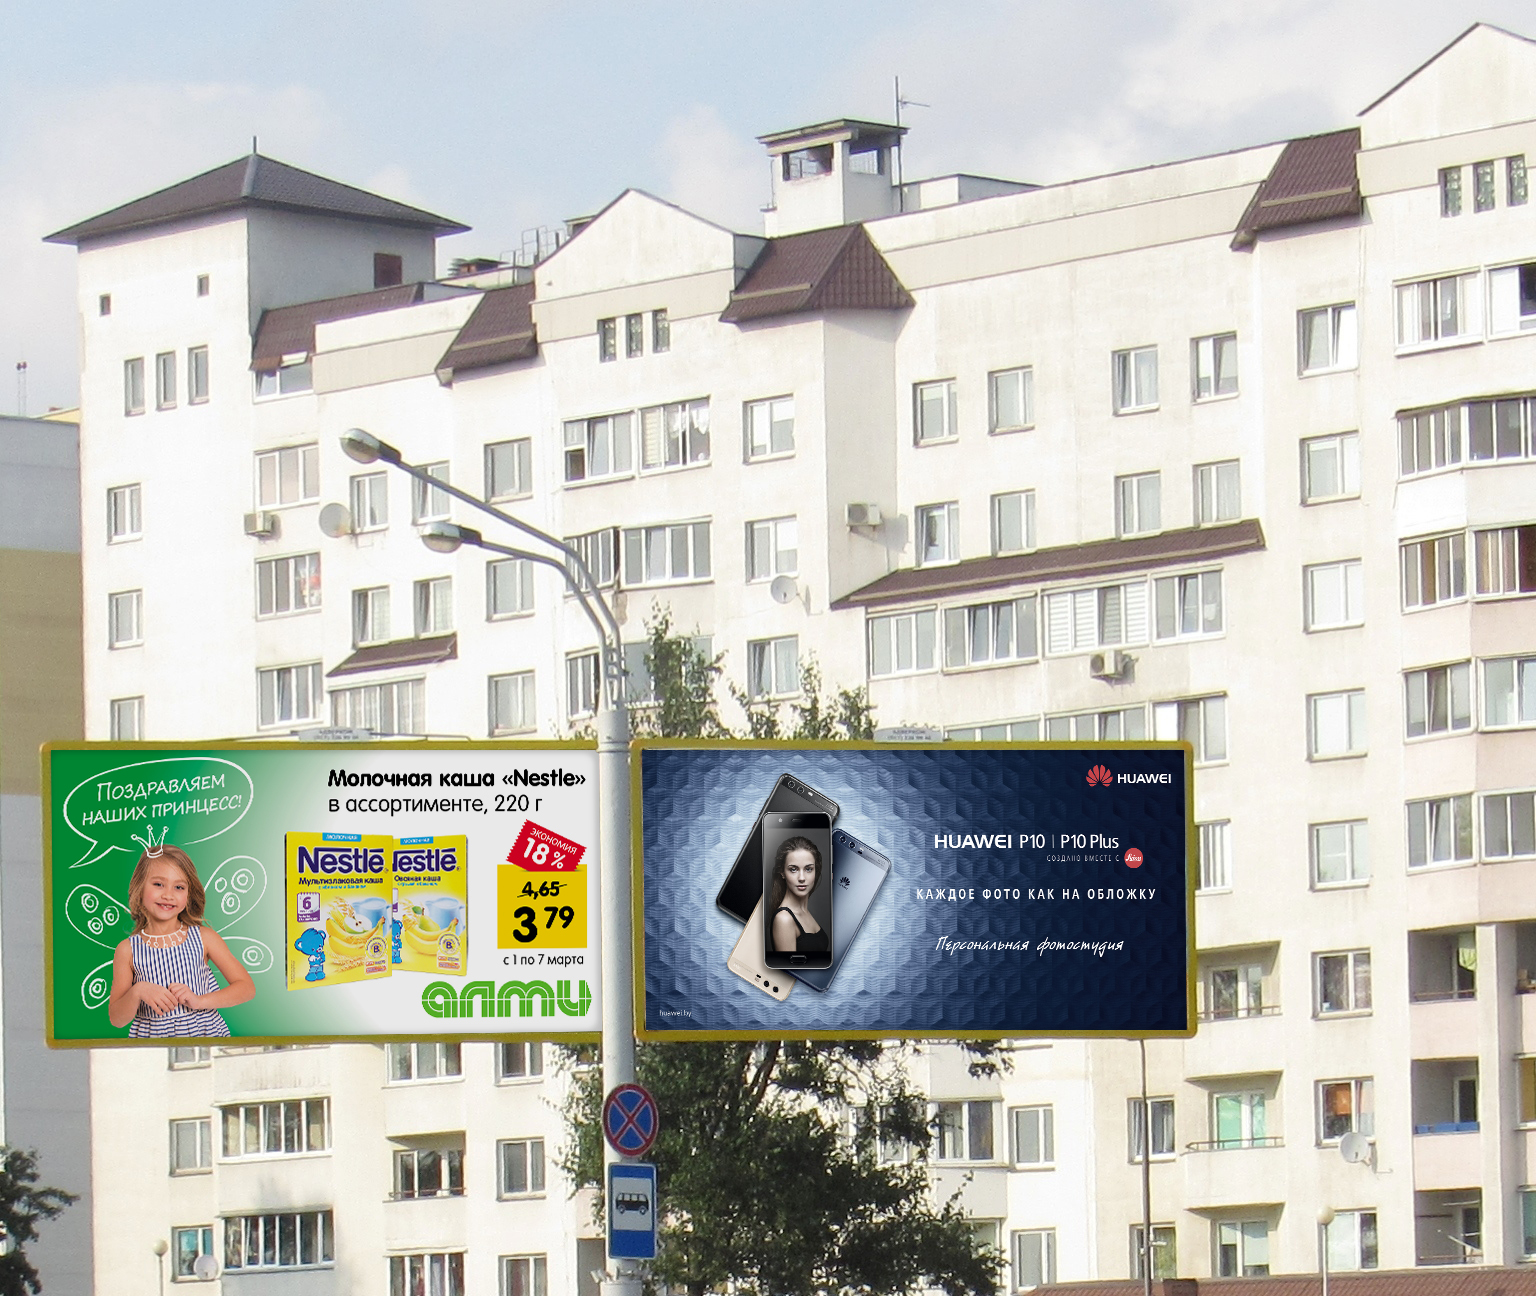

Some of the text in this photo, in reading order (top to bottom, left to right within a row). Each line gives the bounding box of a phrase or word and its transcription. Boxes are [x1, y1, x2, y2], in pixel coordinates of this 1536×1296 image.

[328, 768, 586, 787] Молочная каша «Nestle»
[1117, 773, 1172, 784] HUAWEI
[82, 795, 242, 826] НАШИХ ПРИНЦЕСС!
[328, 795, 543, 817] в ассортименте, 220 г
[530, 827, 578, 855] ЭКОНОМИЯ
[934, 833, 1120, 849] HUAWEI P10 P10 Plus
[521, 881, 560, 900] 4,65
[916, 888, 1156, 901] КАЖДОЕ ФОТО КАК НА ОБЛОЖКУ
[935, 936, 1125, 957] Персональная фотостудия
[520, 956, 535, 965] по
[537, 954, 545, 965] 7
[547, 955, 584, 968] марта
